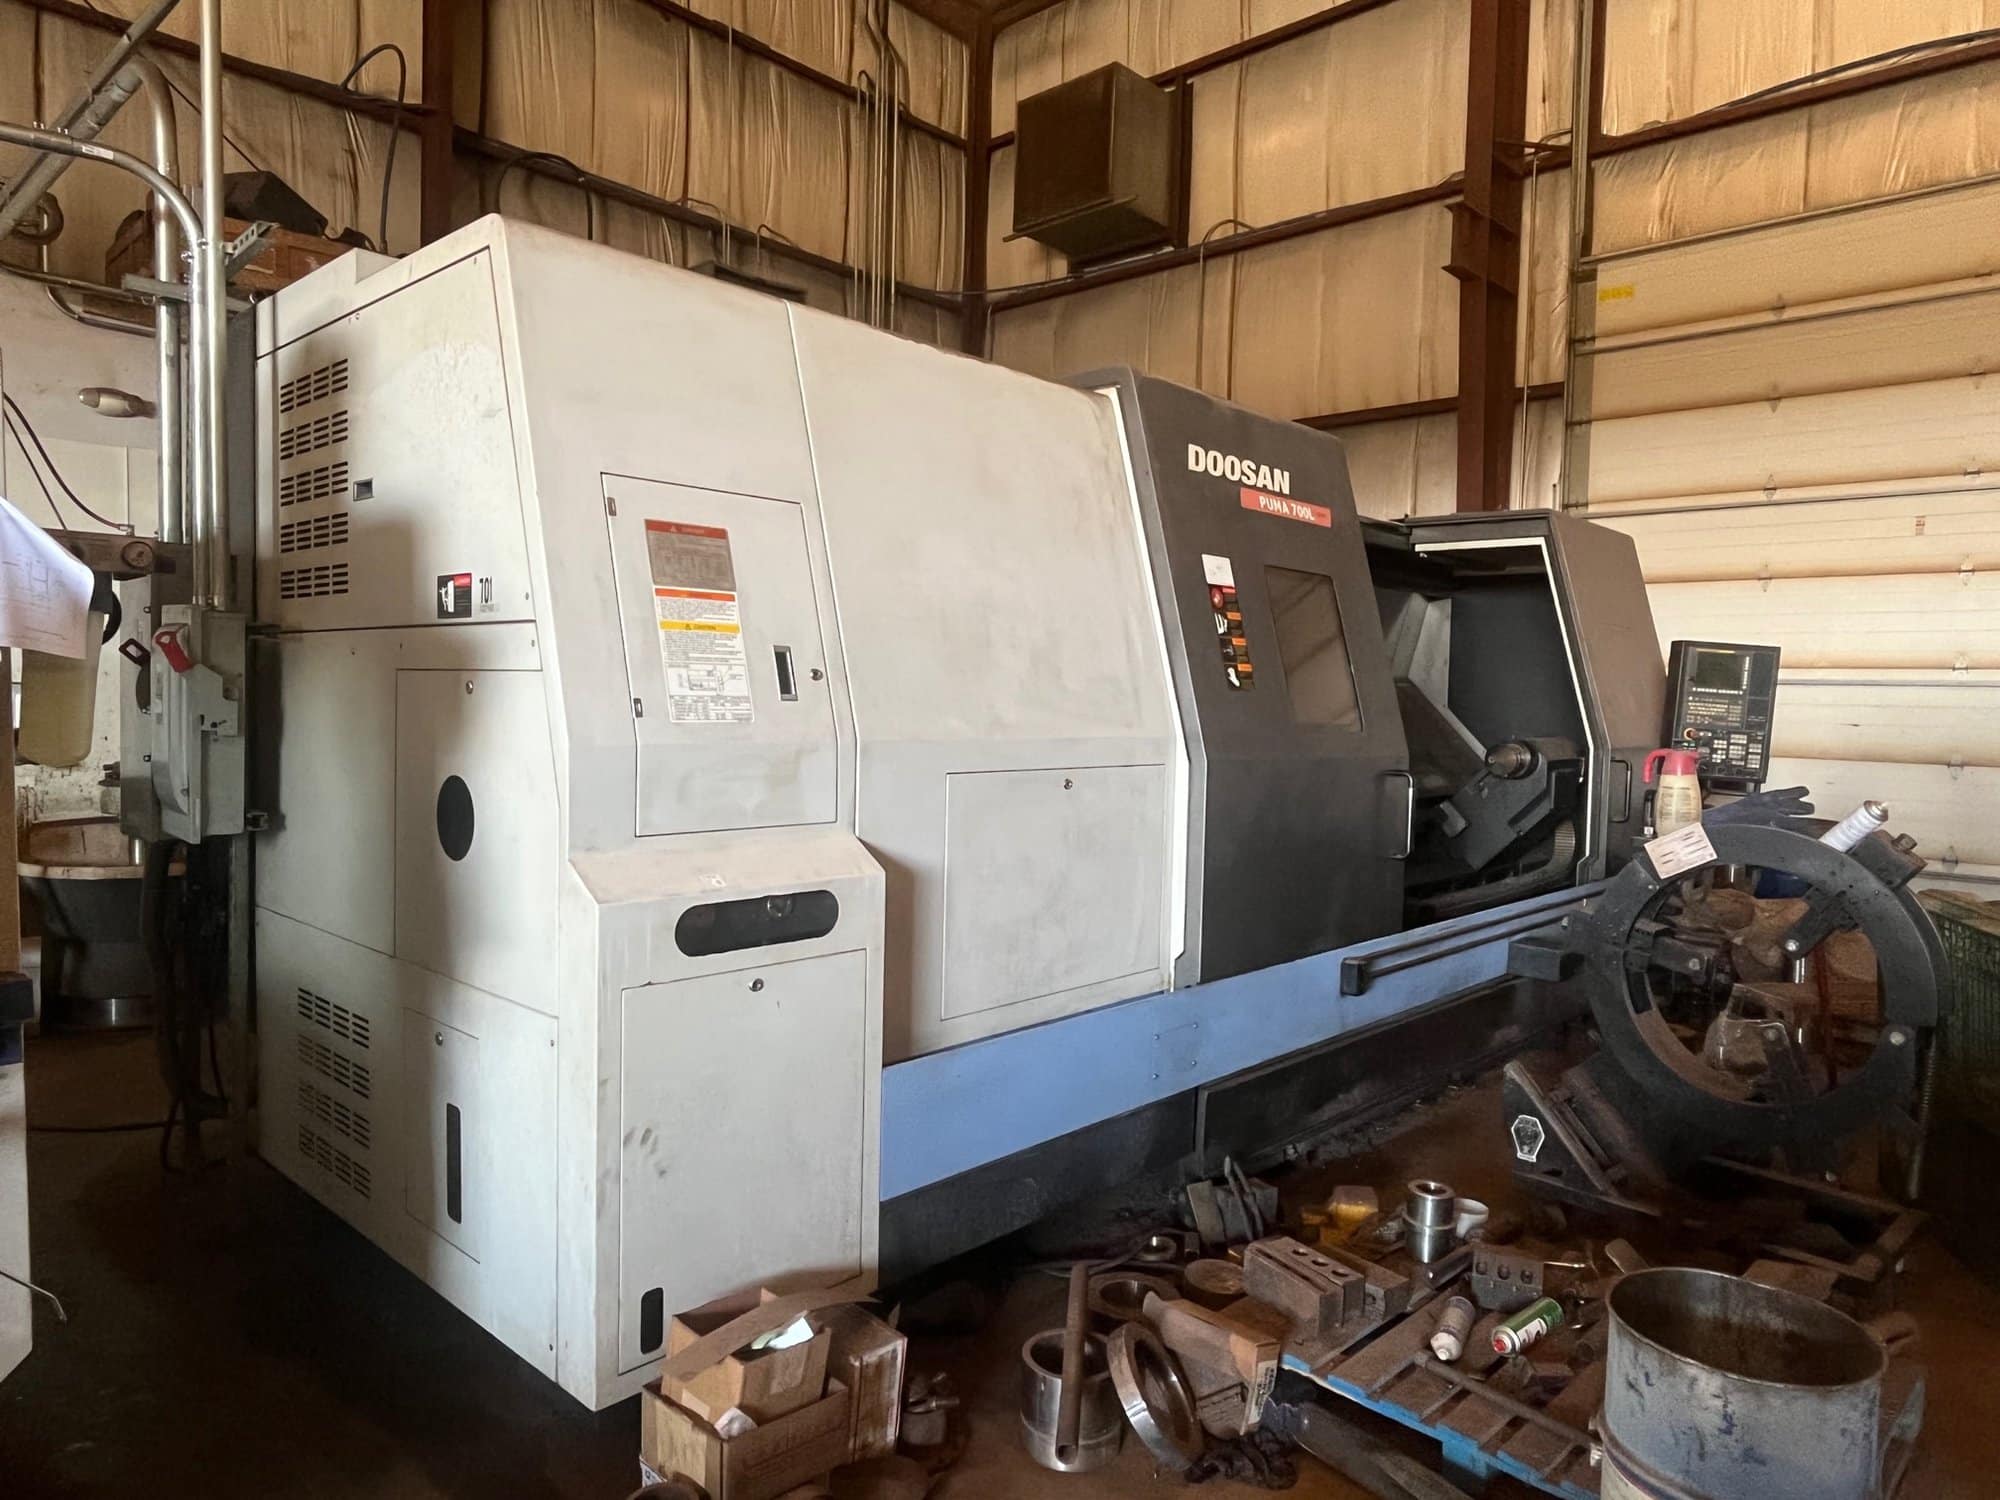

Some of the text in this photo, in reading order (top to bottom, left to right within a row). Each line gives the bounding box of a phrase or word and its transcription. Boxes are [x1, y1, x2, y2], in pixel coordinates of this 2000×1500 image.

[1188, 443, 1290, 495] DOOSAN
[1259, 496, 1315, 521] PUMA 700L
